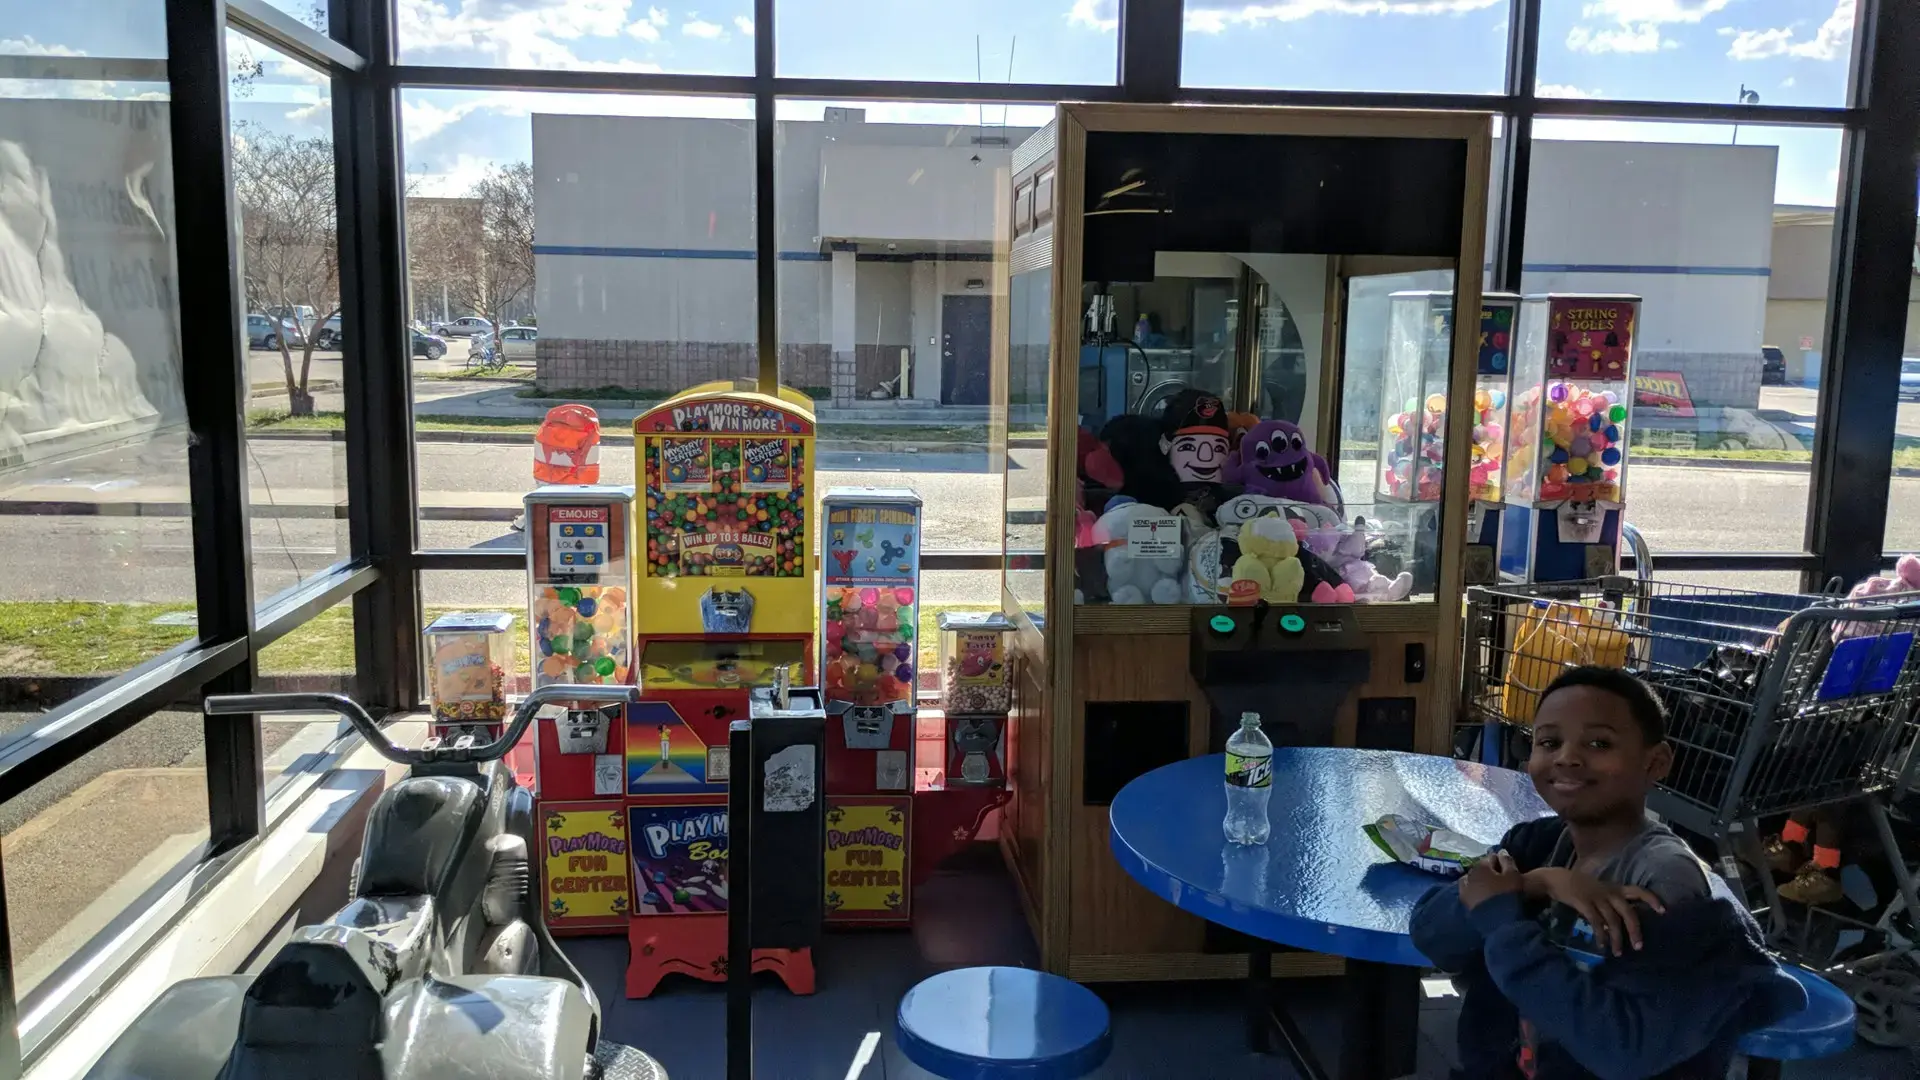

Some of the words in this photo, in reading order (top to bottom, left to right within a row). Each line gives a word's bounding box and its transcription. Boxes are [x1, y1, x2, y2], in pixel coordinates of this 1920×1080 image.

[1567, 308, 1618, 320] STRING
[1570, 320, 1615, 330] DOLLS
[672, 404, 709, 430] PLAY
[713, 403, 749, 417] MORE
[708, 409, 740, 432] WIN
[742, 418, 777, 431] MORE
[669, 449, 703, 464] CENTERS
[749, 449, 782, 464] CENTERS
[559, 509, 598, 518] EMOJIS
[851, 508, 876, 523] FIDGET
[556, 541, 573, 549] LOL
[683, 535, 703, 547] WIN
[705, 533, 718, 543] UP
[720, 533, 731, 542] TO
[733, 533, 739, 542] 3
[741, 534, 773, 547] BALLS!
[1247, 757, 1272, 786] ICE
[568, 856, 608, 872] FUN
[845, 850, 883, 866] FUN
[550, 875, 627, 894] CENTER
[827, 870, 901, 887] CENTER
